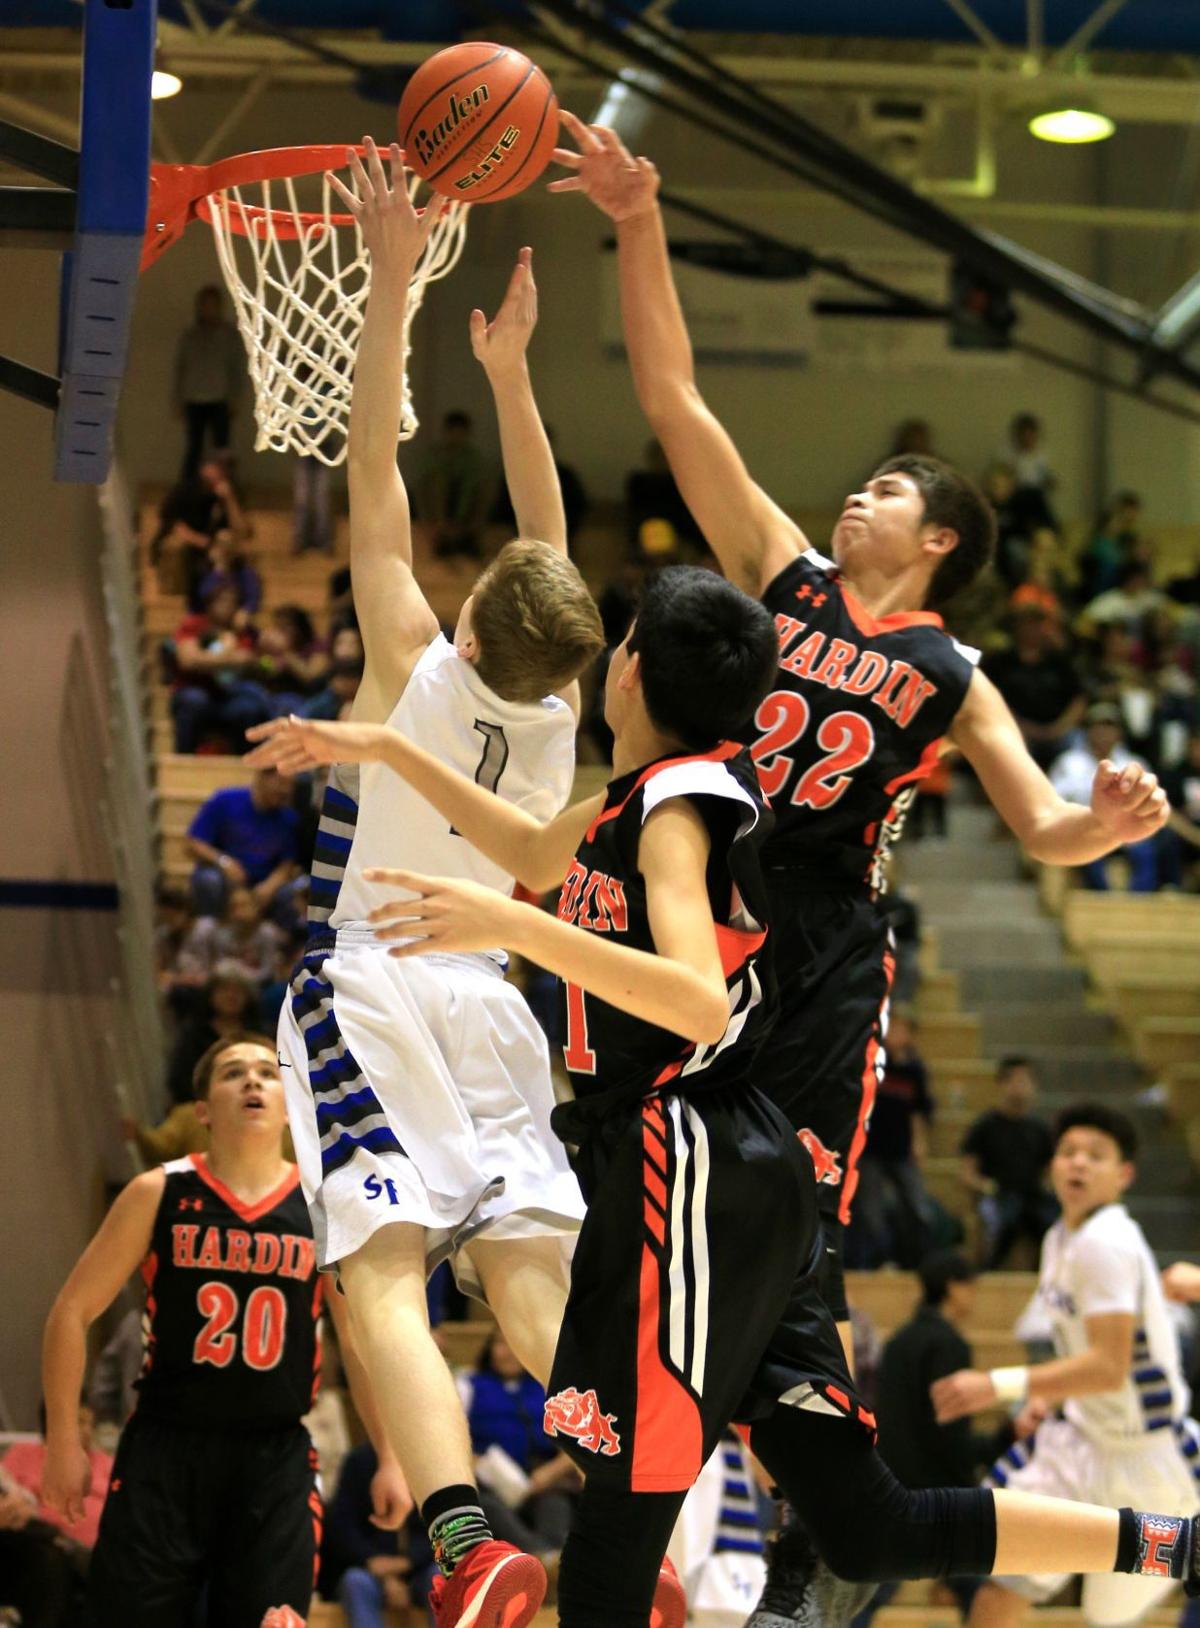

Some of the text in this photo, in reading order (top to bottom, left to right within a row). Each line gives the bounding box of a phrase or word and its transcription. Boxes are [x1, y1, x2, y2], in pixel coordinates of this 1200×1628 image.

[414, 84, 490, 167] Baden
[453, 125, 520, 191] ELITE
[774, 612, 939, 729] HARDIN
[750, 689, 875, 811] 22
[556, 857, 629, 932] DIN
[171, 1224, 317, 1283] HARDIN
[192, 1281, 288, 1372] 20
